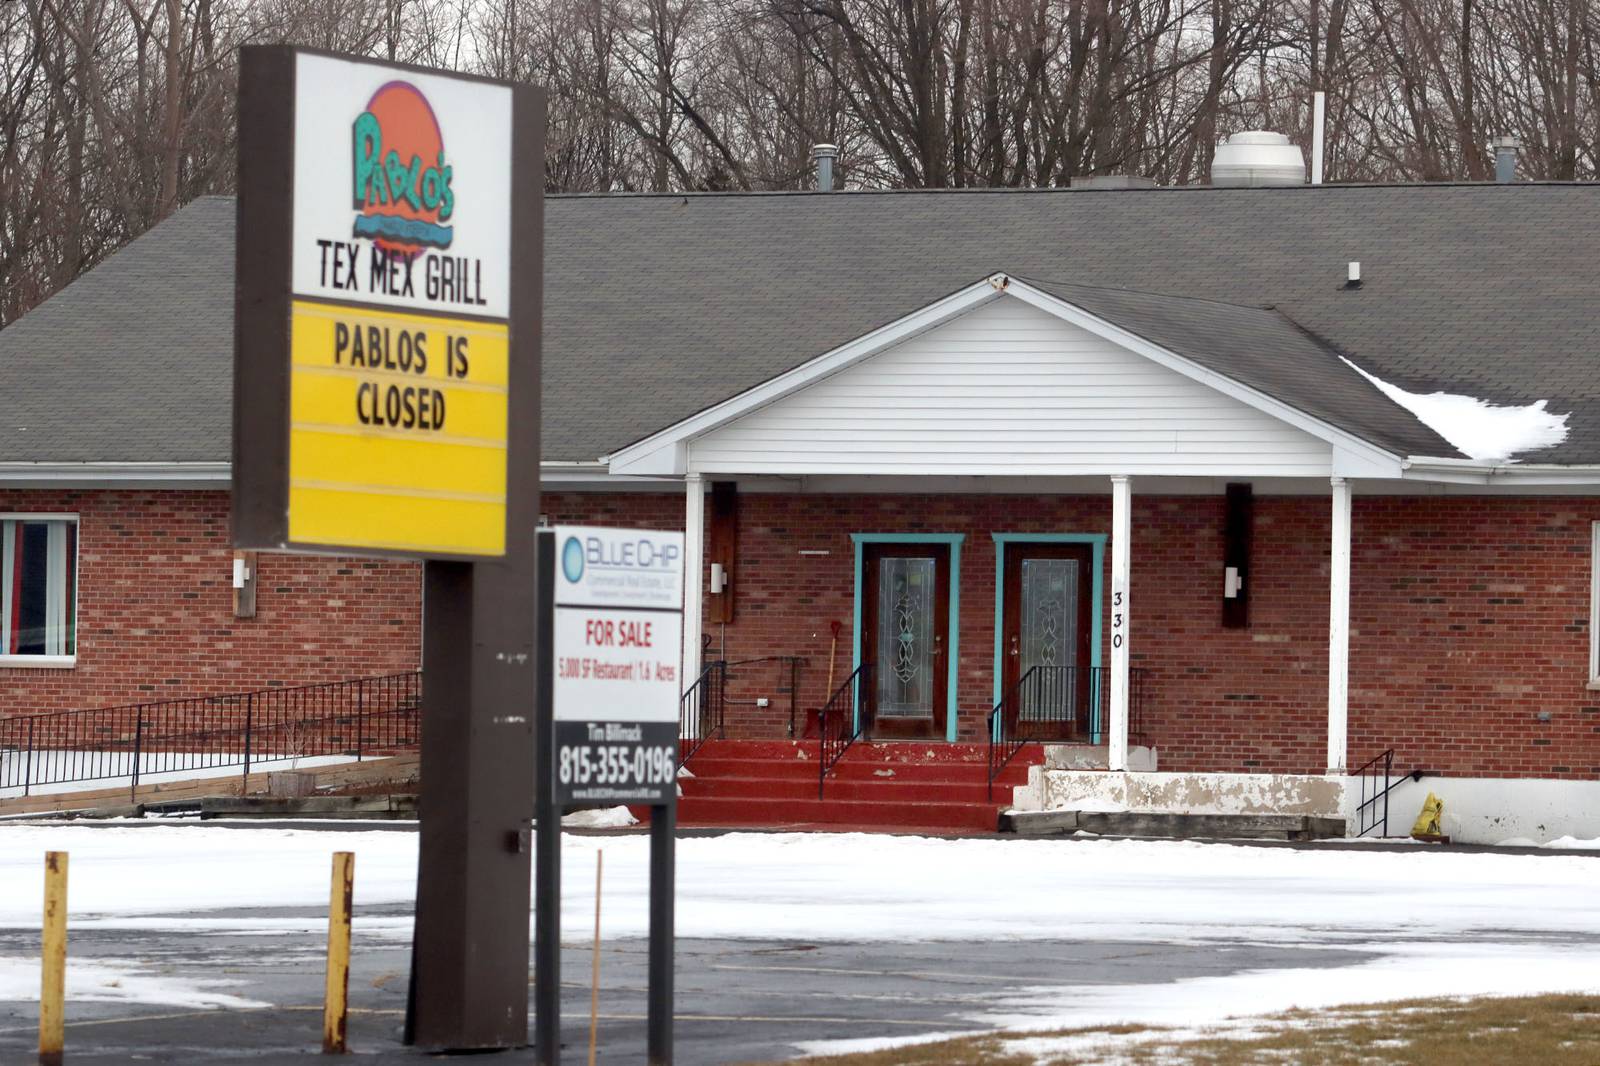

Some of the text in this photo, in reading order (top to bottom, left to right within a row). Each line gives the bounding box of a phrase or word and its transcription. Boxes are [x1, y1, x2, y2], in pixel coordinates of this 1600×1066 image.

[317, 239, 487, 305] TEX MEX GRILL
[335, 322, 468, 431] PABLOS IS CLOSED
[586, 619, 653, 647] FOR SALE
[1113, 592, 1122, 648] 330
[593, 658, 633, 680] Restaurant
[560, 745, 674, 784] 815-355-0196
